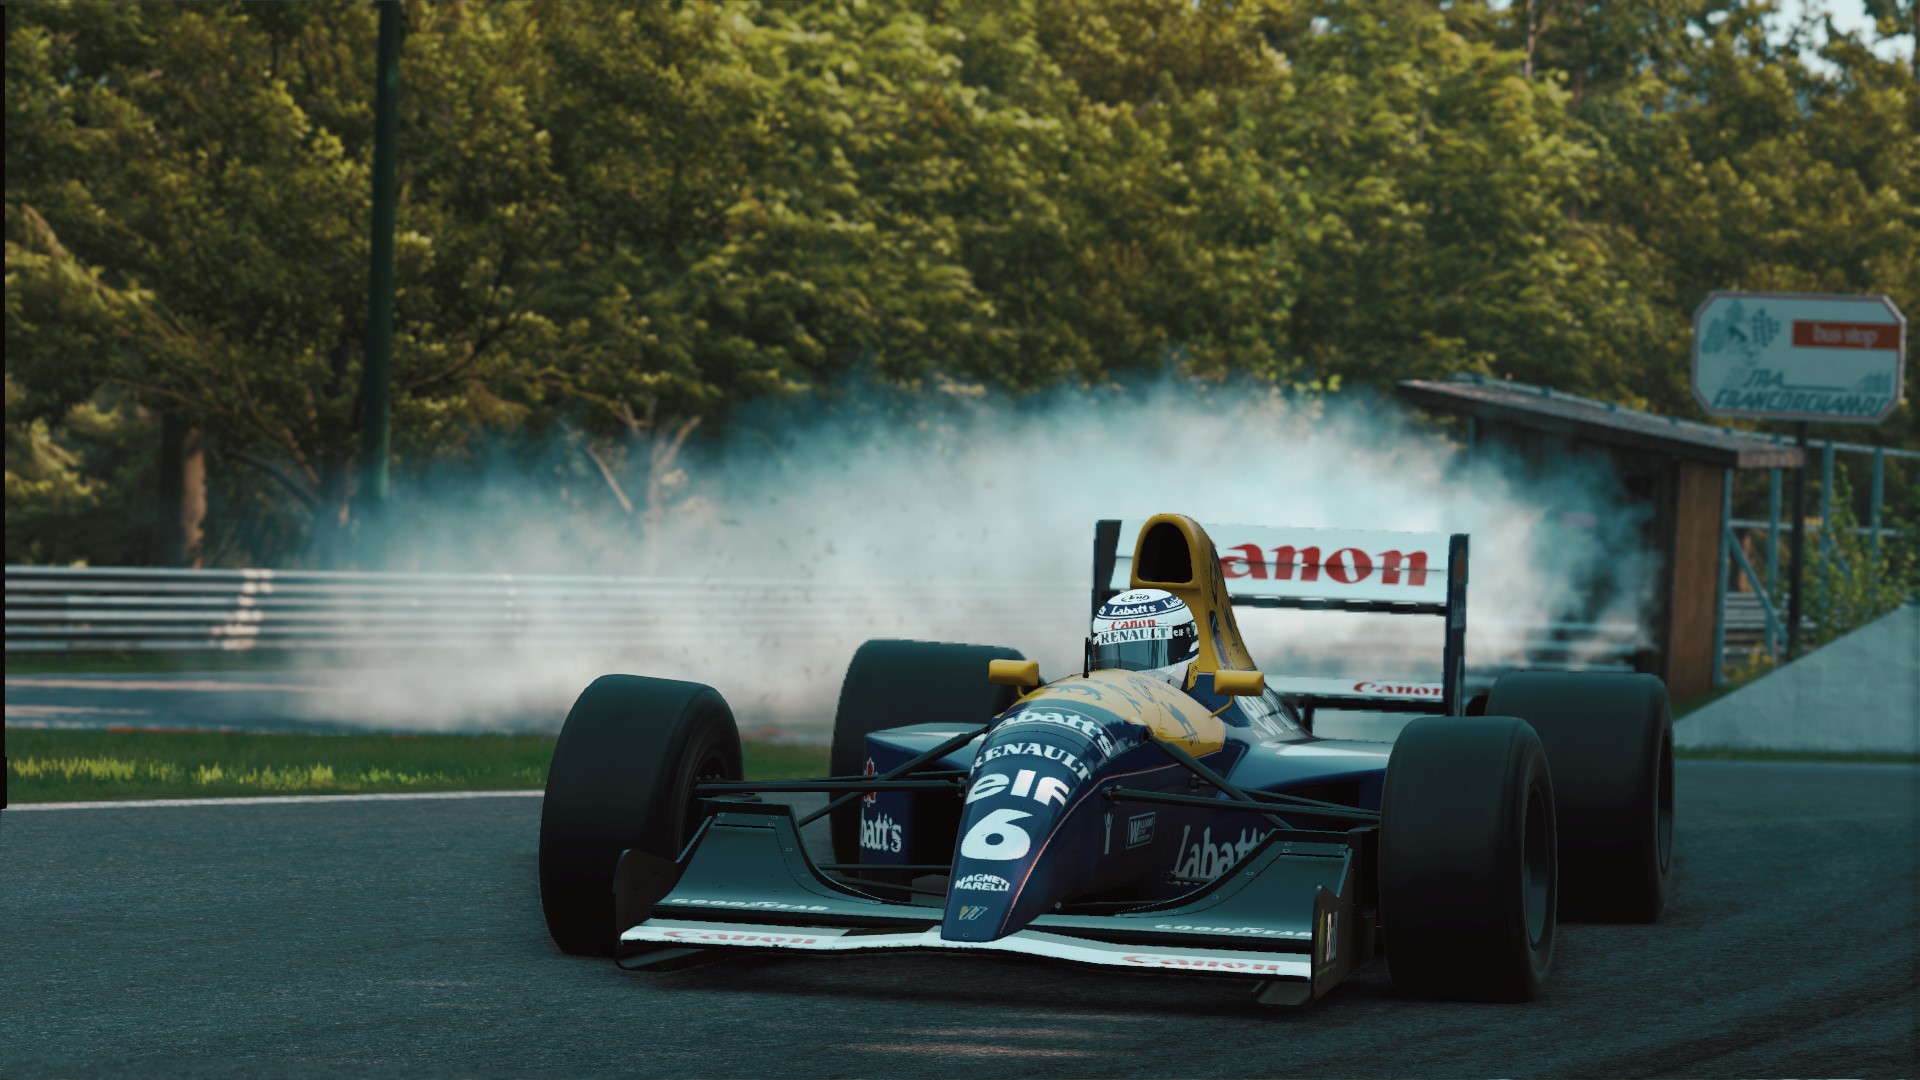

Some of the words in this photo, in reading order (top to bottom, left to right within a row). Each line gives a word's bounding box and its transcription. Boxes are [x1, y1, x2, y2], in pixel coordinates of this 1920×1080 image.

[1812, 324, 1841, 342] bus
[1845, 327, 1878, 347] stop
[1212, 541, 1428, 587] anon
[1101, 627, 1169, 644] RENAULT
[1111, 619, 1156, 631] Canon
[970, 742, 1091, 783] RENAULT
[966, 769, 1070, 806] elf
[861, 807, 902, 853] batt's
[961, 808, 1034, 861] 6
